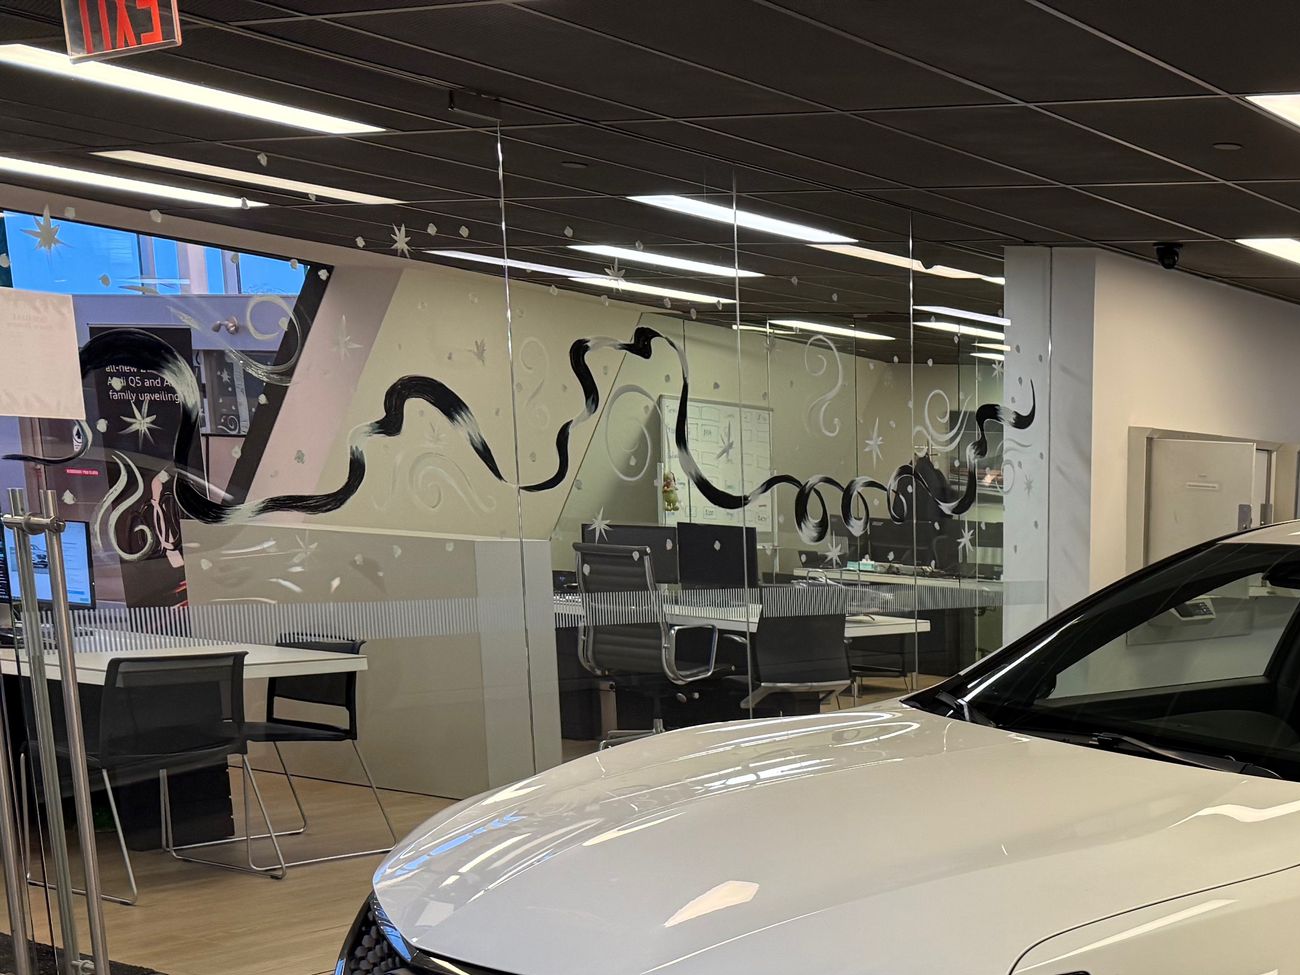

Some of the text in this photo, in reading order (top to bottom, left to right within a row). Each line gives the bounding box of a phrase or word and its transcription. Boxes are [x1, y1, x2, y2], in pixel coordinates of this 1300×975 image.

[107, 376, 126, 386] Ai
[128, 376, 141, 387] Q5
[144, 377, 161, 386] and
[109, 390, 180, 403] family unveiling
